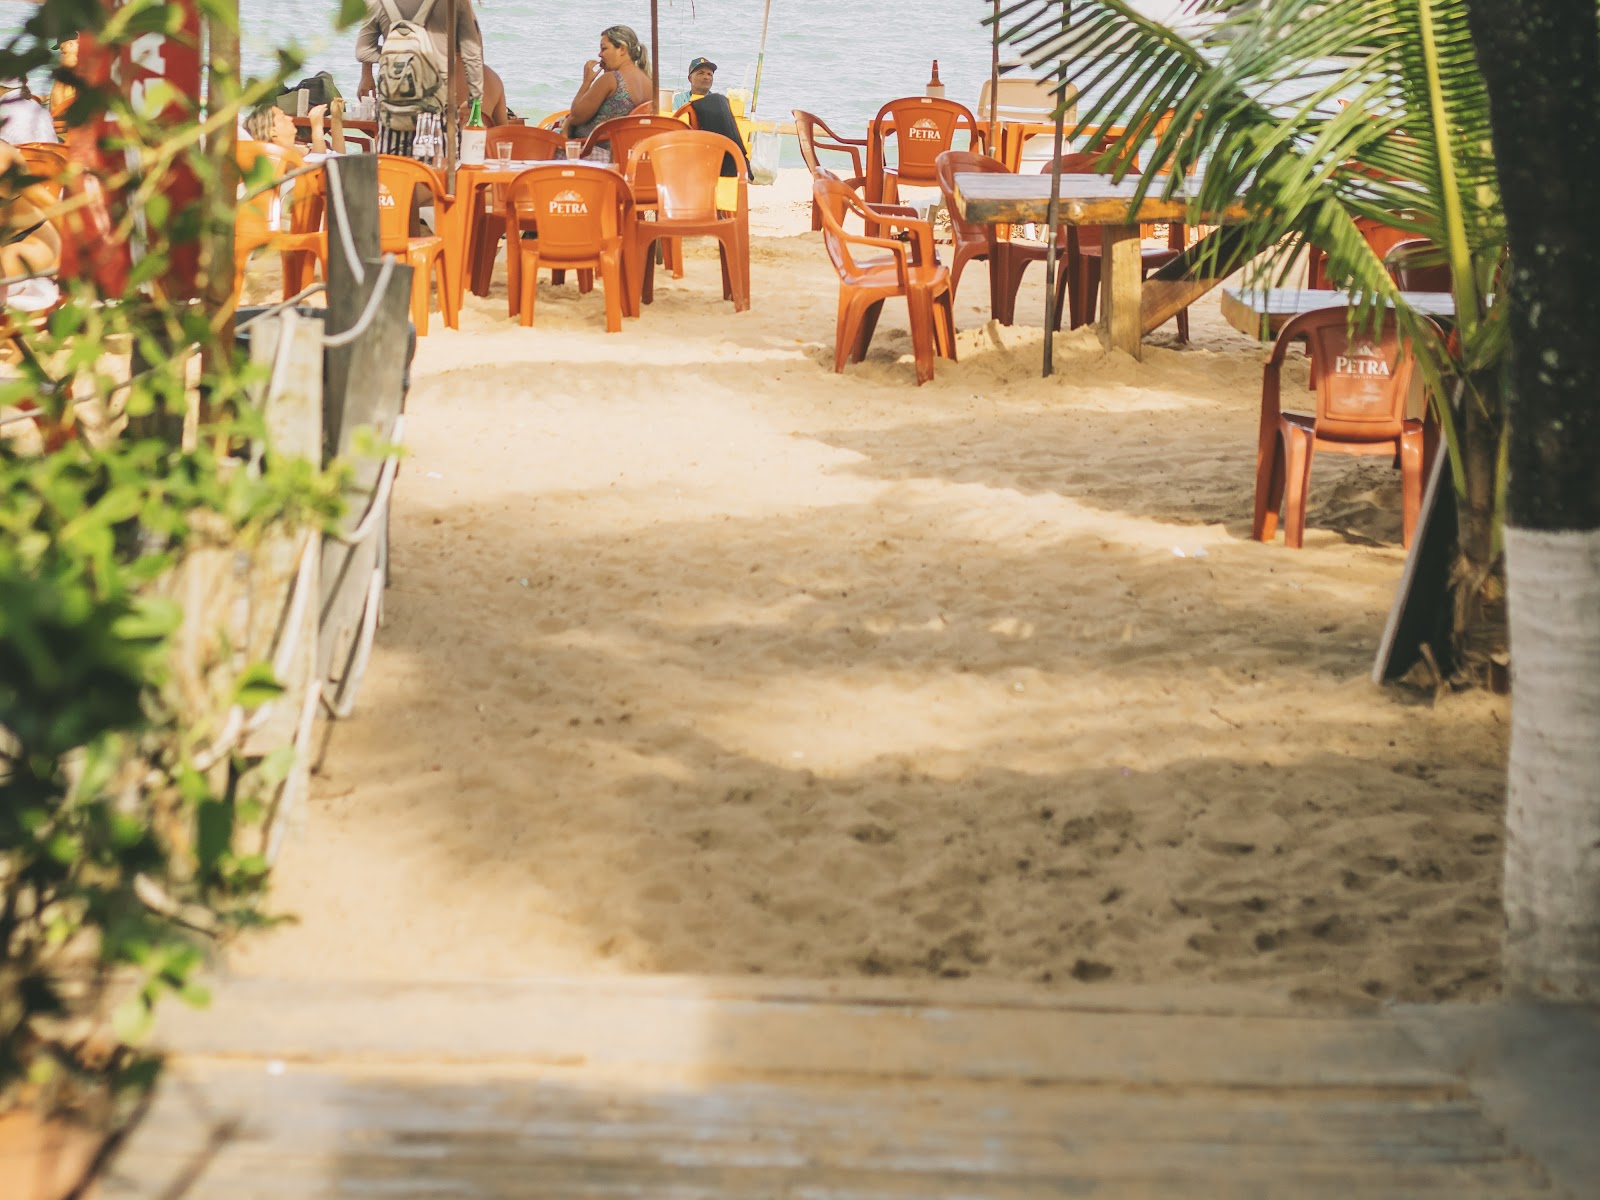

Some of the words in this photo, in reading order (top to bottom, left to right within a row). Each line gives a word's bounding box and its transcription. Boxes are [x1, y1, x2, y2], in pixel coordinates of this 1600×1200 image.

[909, 127, 941, 139] PETRA
[549, 201, 588, 213] PETRA
[1335, 355, 1389, 375] PETRA
